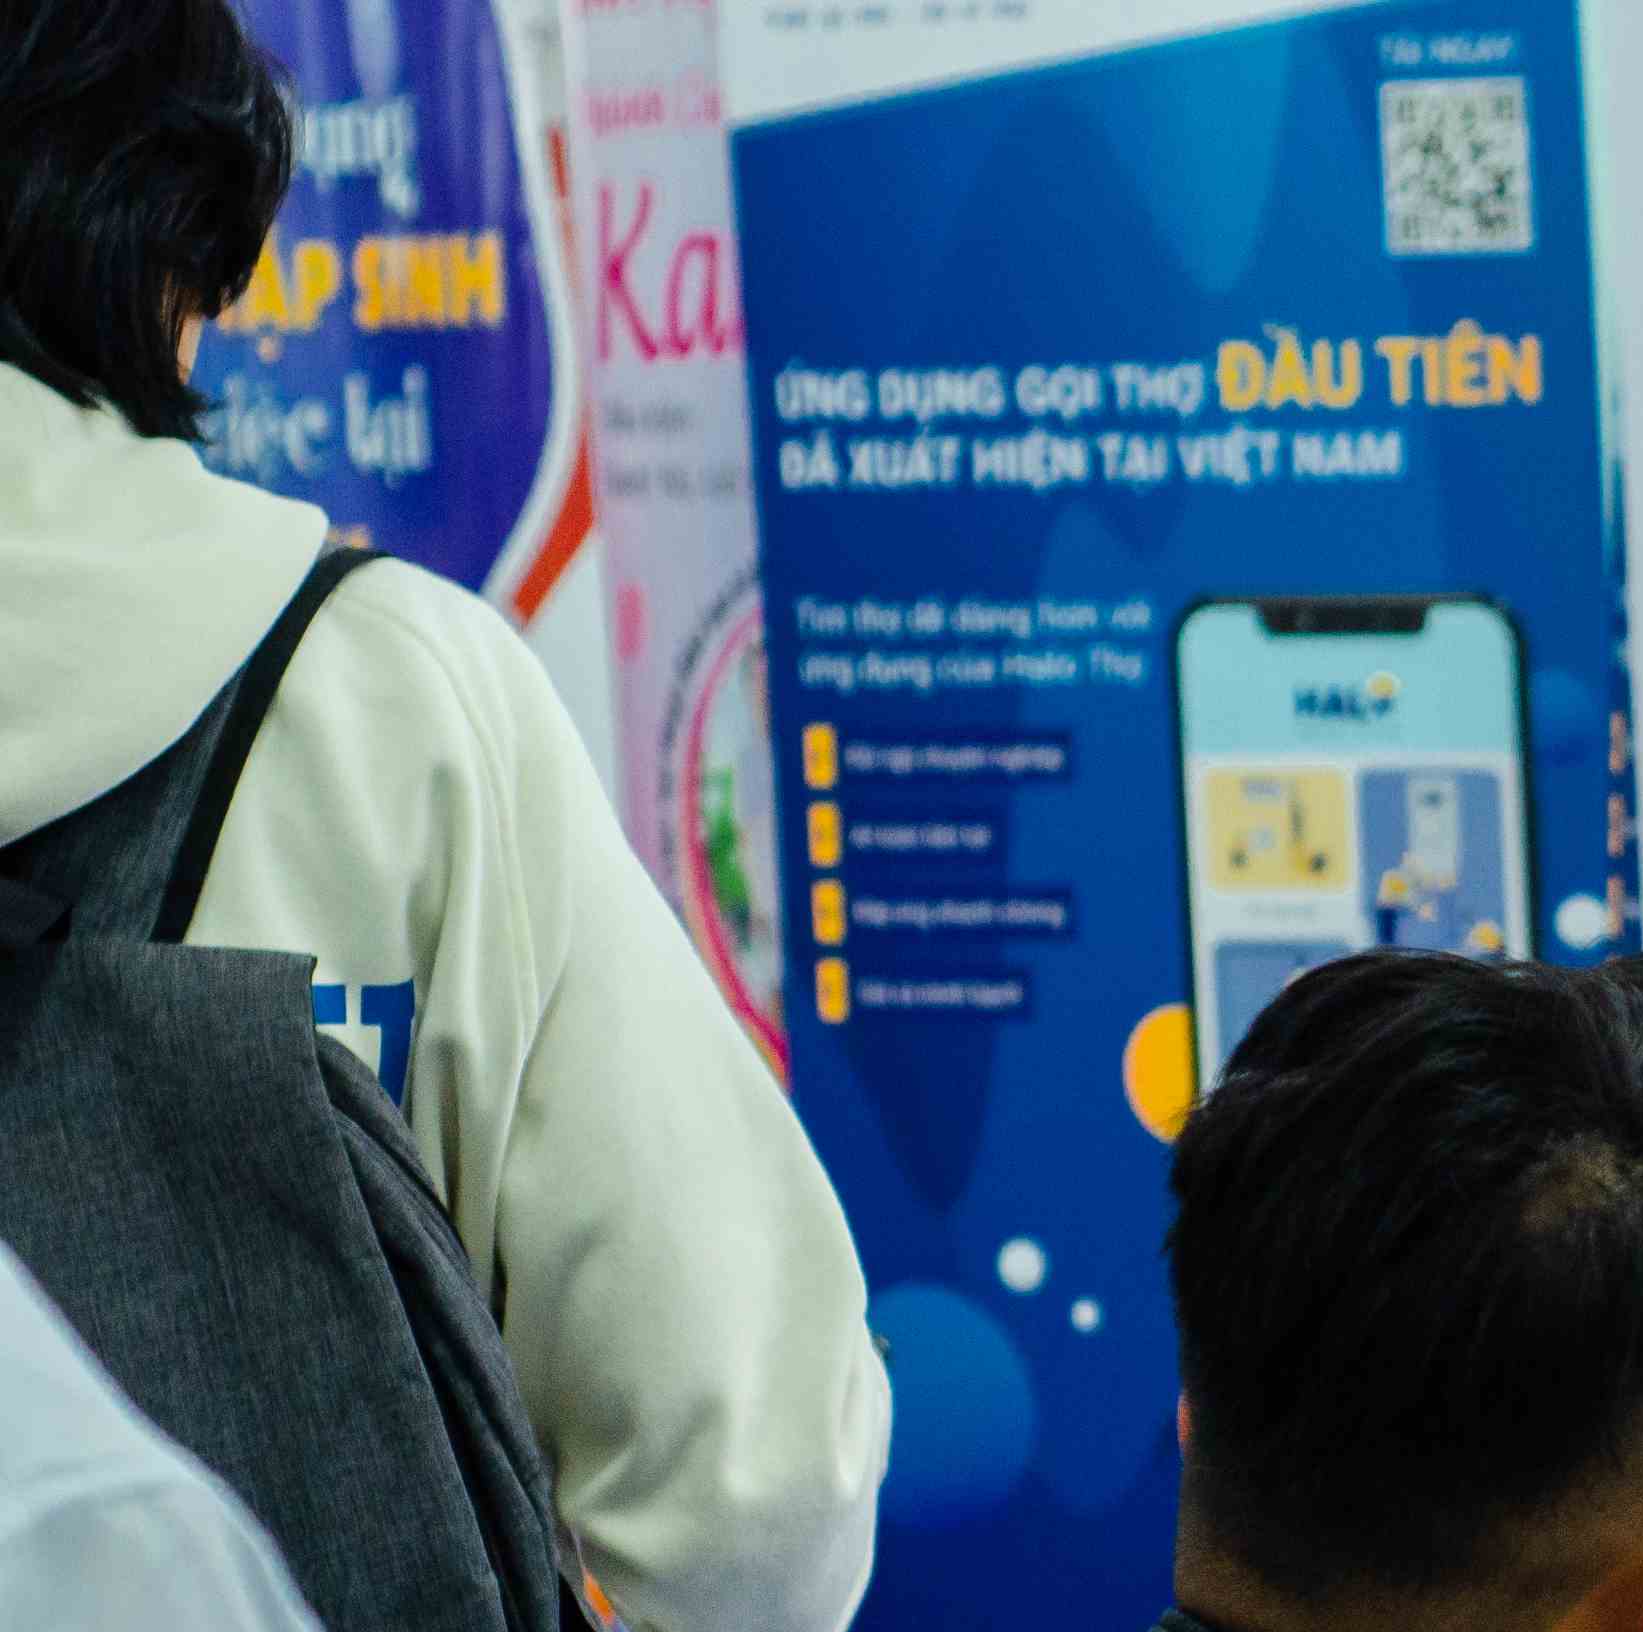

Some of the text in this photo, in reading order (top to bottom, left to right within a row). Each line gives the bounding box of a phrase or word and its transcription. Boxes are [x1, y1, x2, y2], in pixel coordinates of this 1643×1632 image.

[353, 229, 506, 332] SINH
[774, 357, 870, 421] ỨNG
[878, 367, 1006, 424] DỤNG
[1016, 364, 1098, 421] GỌI
[1215, 322, 1362, 412] ĐẦU
[1374, 317, 1542, 408] TIÊN
[848, 421, 961, 487] XUẤT
[972, 427, 1088, 493] HIỆN
[1177, 422, 1281, 485] VIỆT
[1291, 429, 1404, 477] NAM
